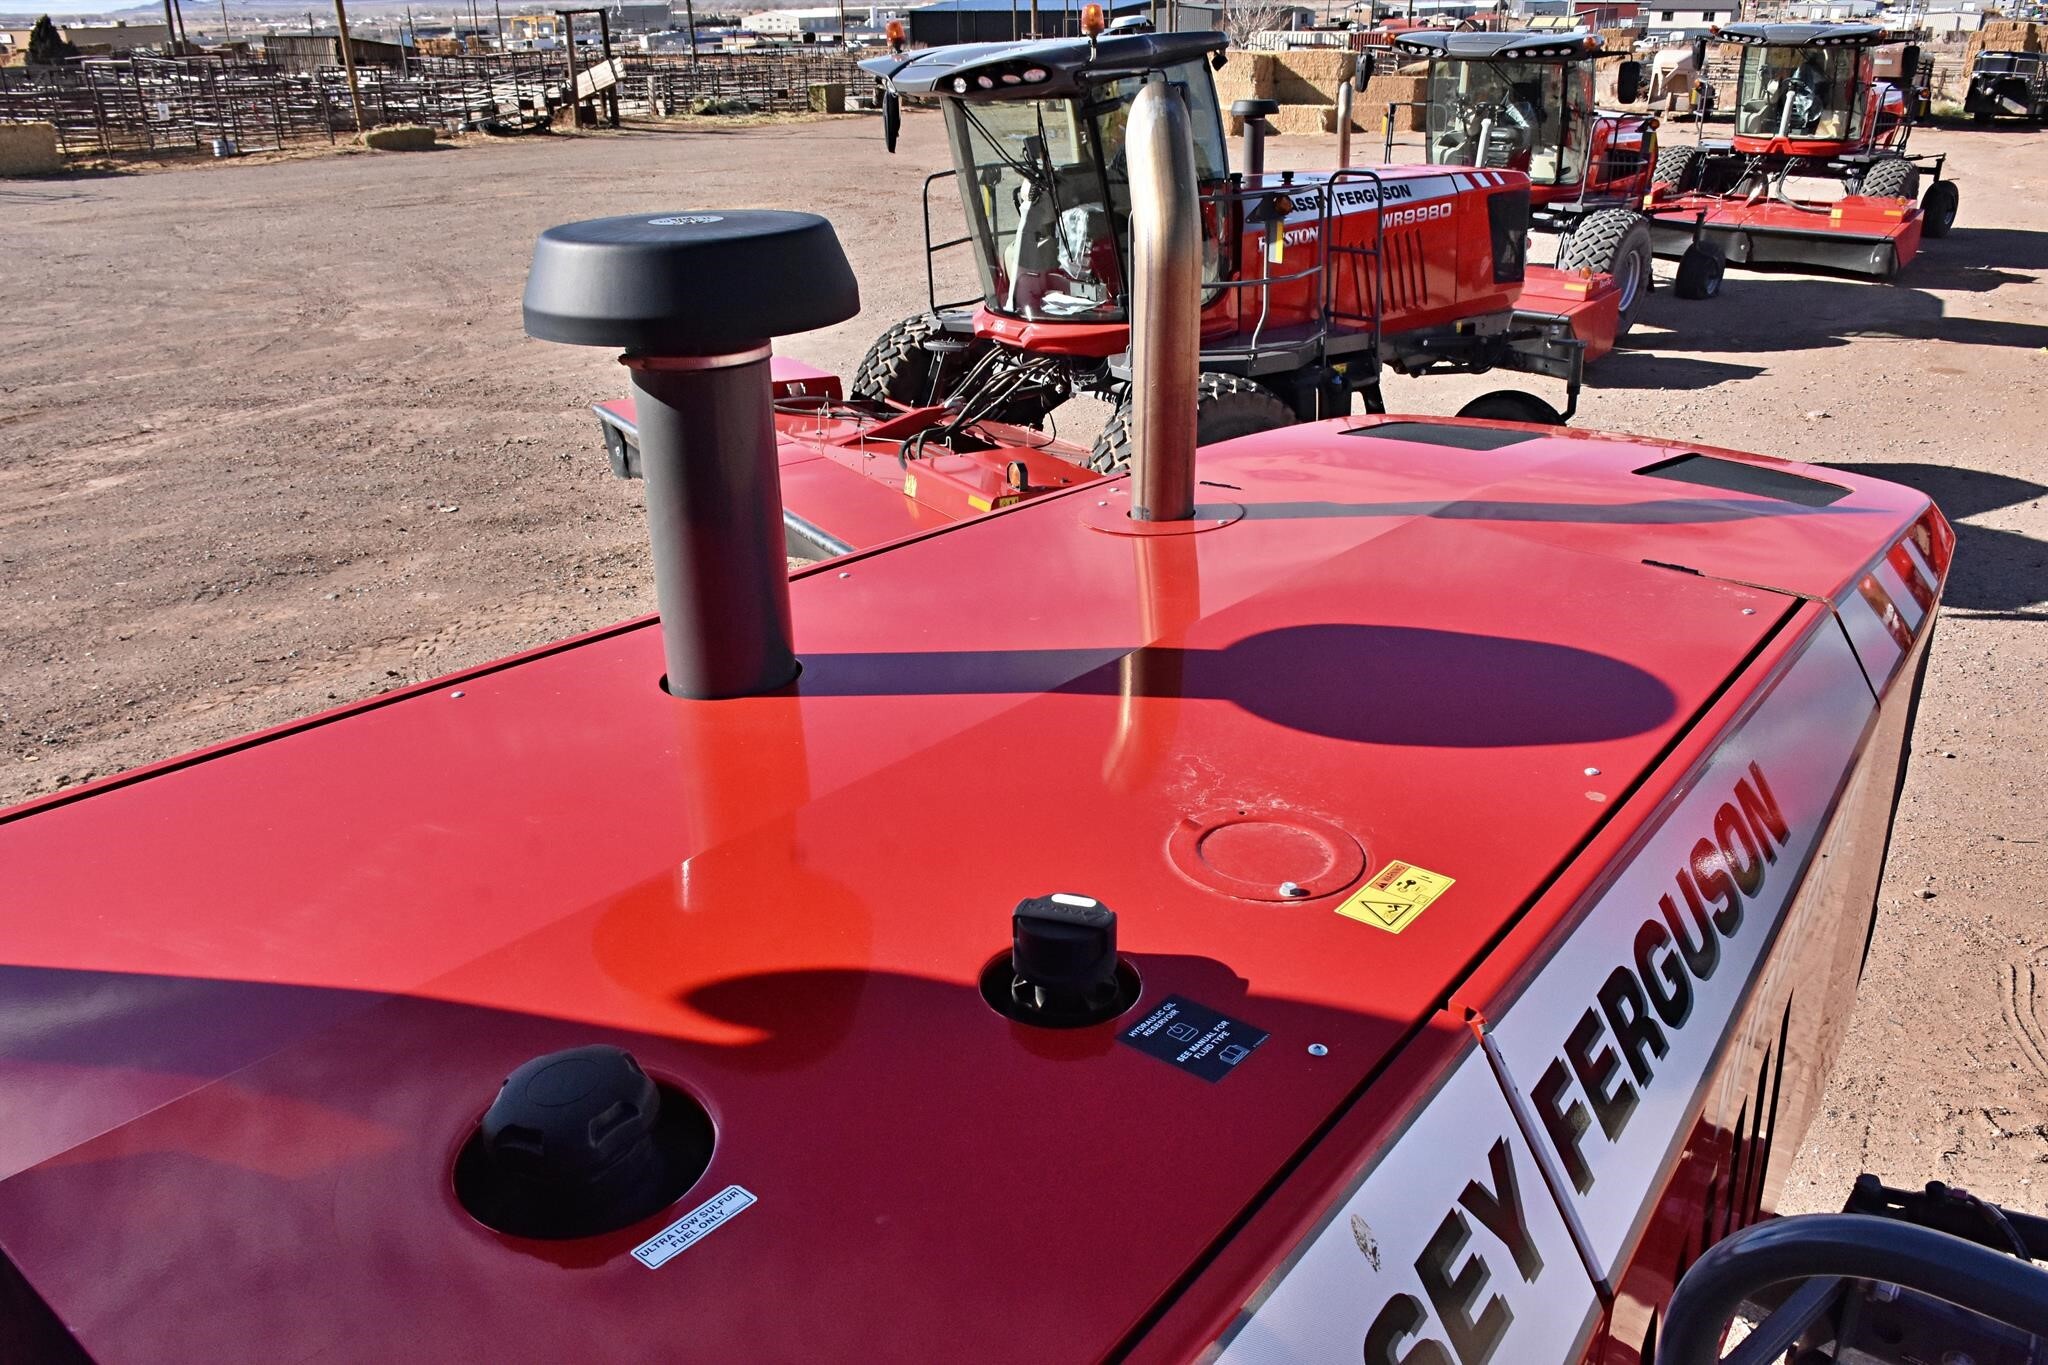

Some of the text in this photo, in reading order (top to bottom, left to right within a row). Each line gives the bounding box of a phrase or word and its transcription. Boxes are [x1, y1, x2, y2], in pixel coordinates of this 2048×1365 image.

[1382, 202, 1452, 229] WR9980
[1258, 226, 1319, 252] HSTON
[1530, 760, 1791, 1198] FERGUSON
[1128, 1001, 1177, 1037] HYDRAULIC OIL
[1142, 1009, 1180, 1037] RESERVOIR
[1176, 1020, 1230, 1063] SEE MANUAL FOR
[1193, 1030, 1231, 1060] FLUID TYPE
[640, 1234, 677, 1257] ULTRA
[674, 1216, 700, 1235] LOW
[700, 1191, 740, 1218] SULFUR
[671, 1209, 726, 1248] FUEL ONLY
